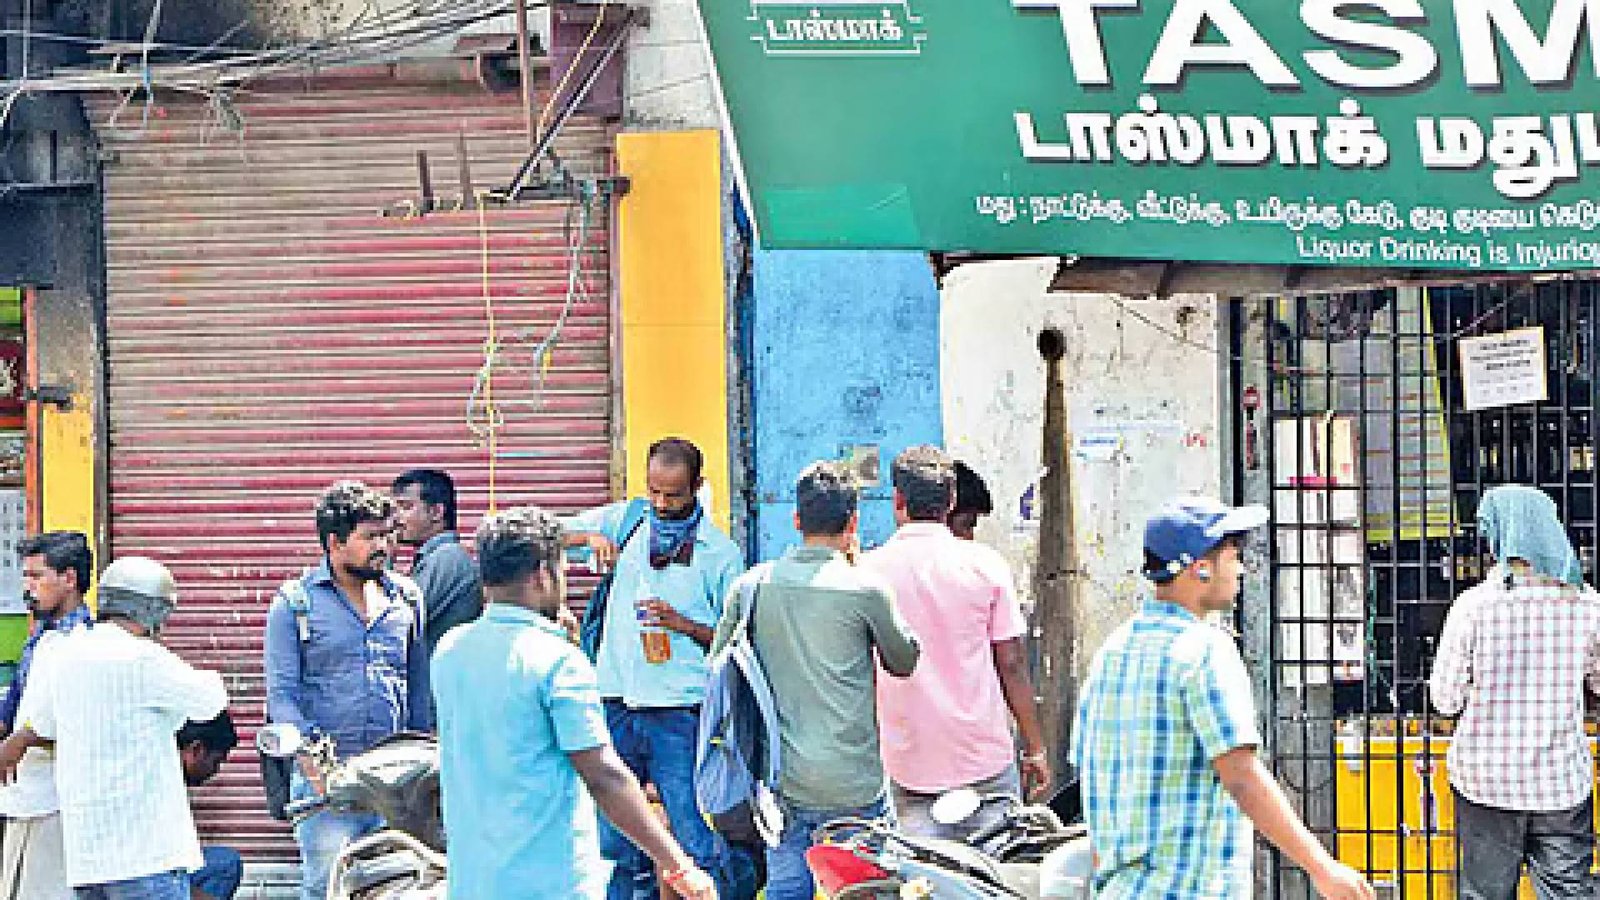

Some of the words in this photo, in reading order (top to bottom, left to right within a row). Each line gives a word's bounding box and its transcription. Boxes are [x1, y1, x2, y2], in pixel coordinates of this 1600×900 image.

[765, 8, 903, 40] டாஸ்மாக்
[1012, 0, 1600, 87] TASM
[1013, 93, 1388, 166] டாஸ்மாக்
[1296, 235, 1374, 263] Liquor
[1379, 236, 1481, 267] Drinking
[1516, 236, 1600, 268] Injurio
